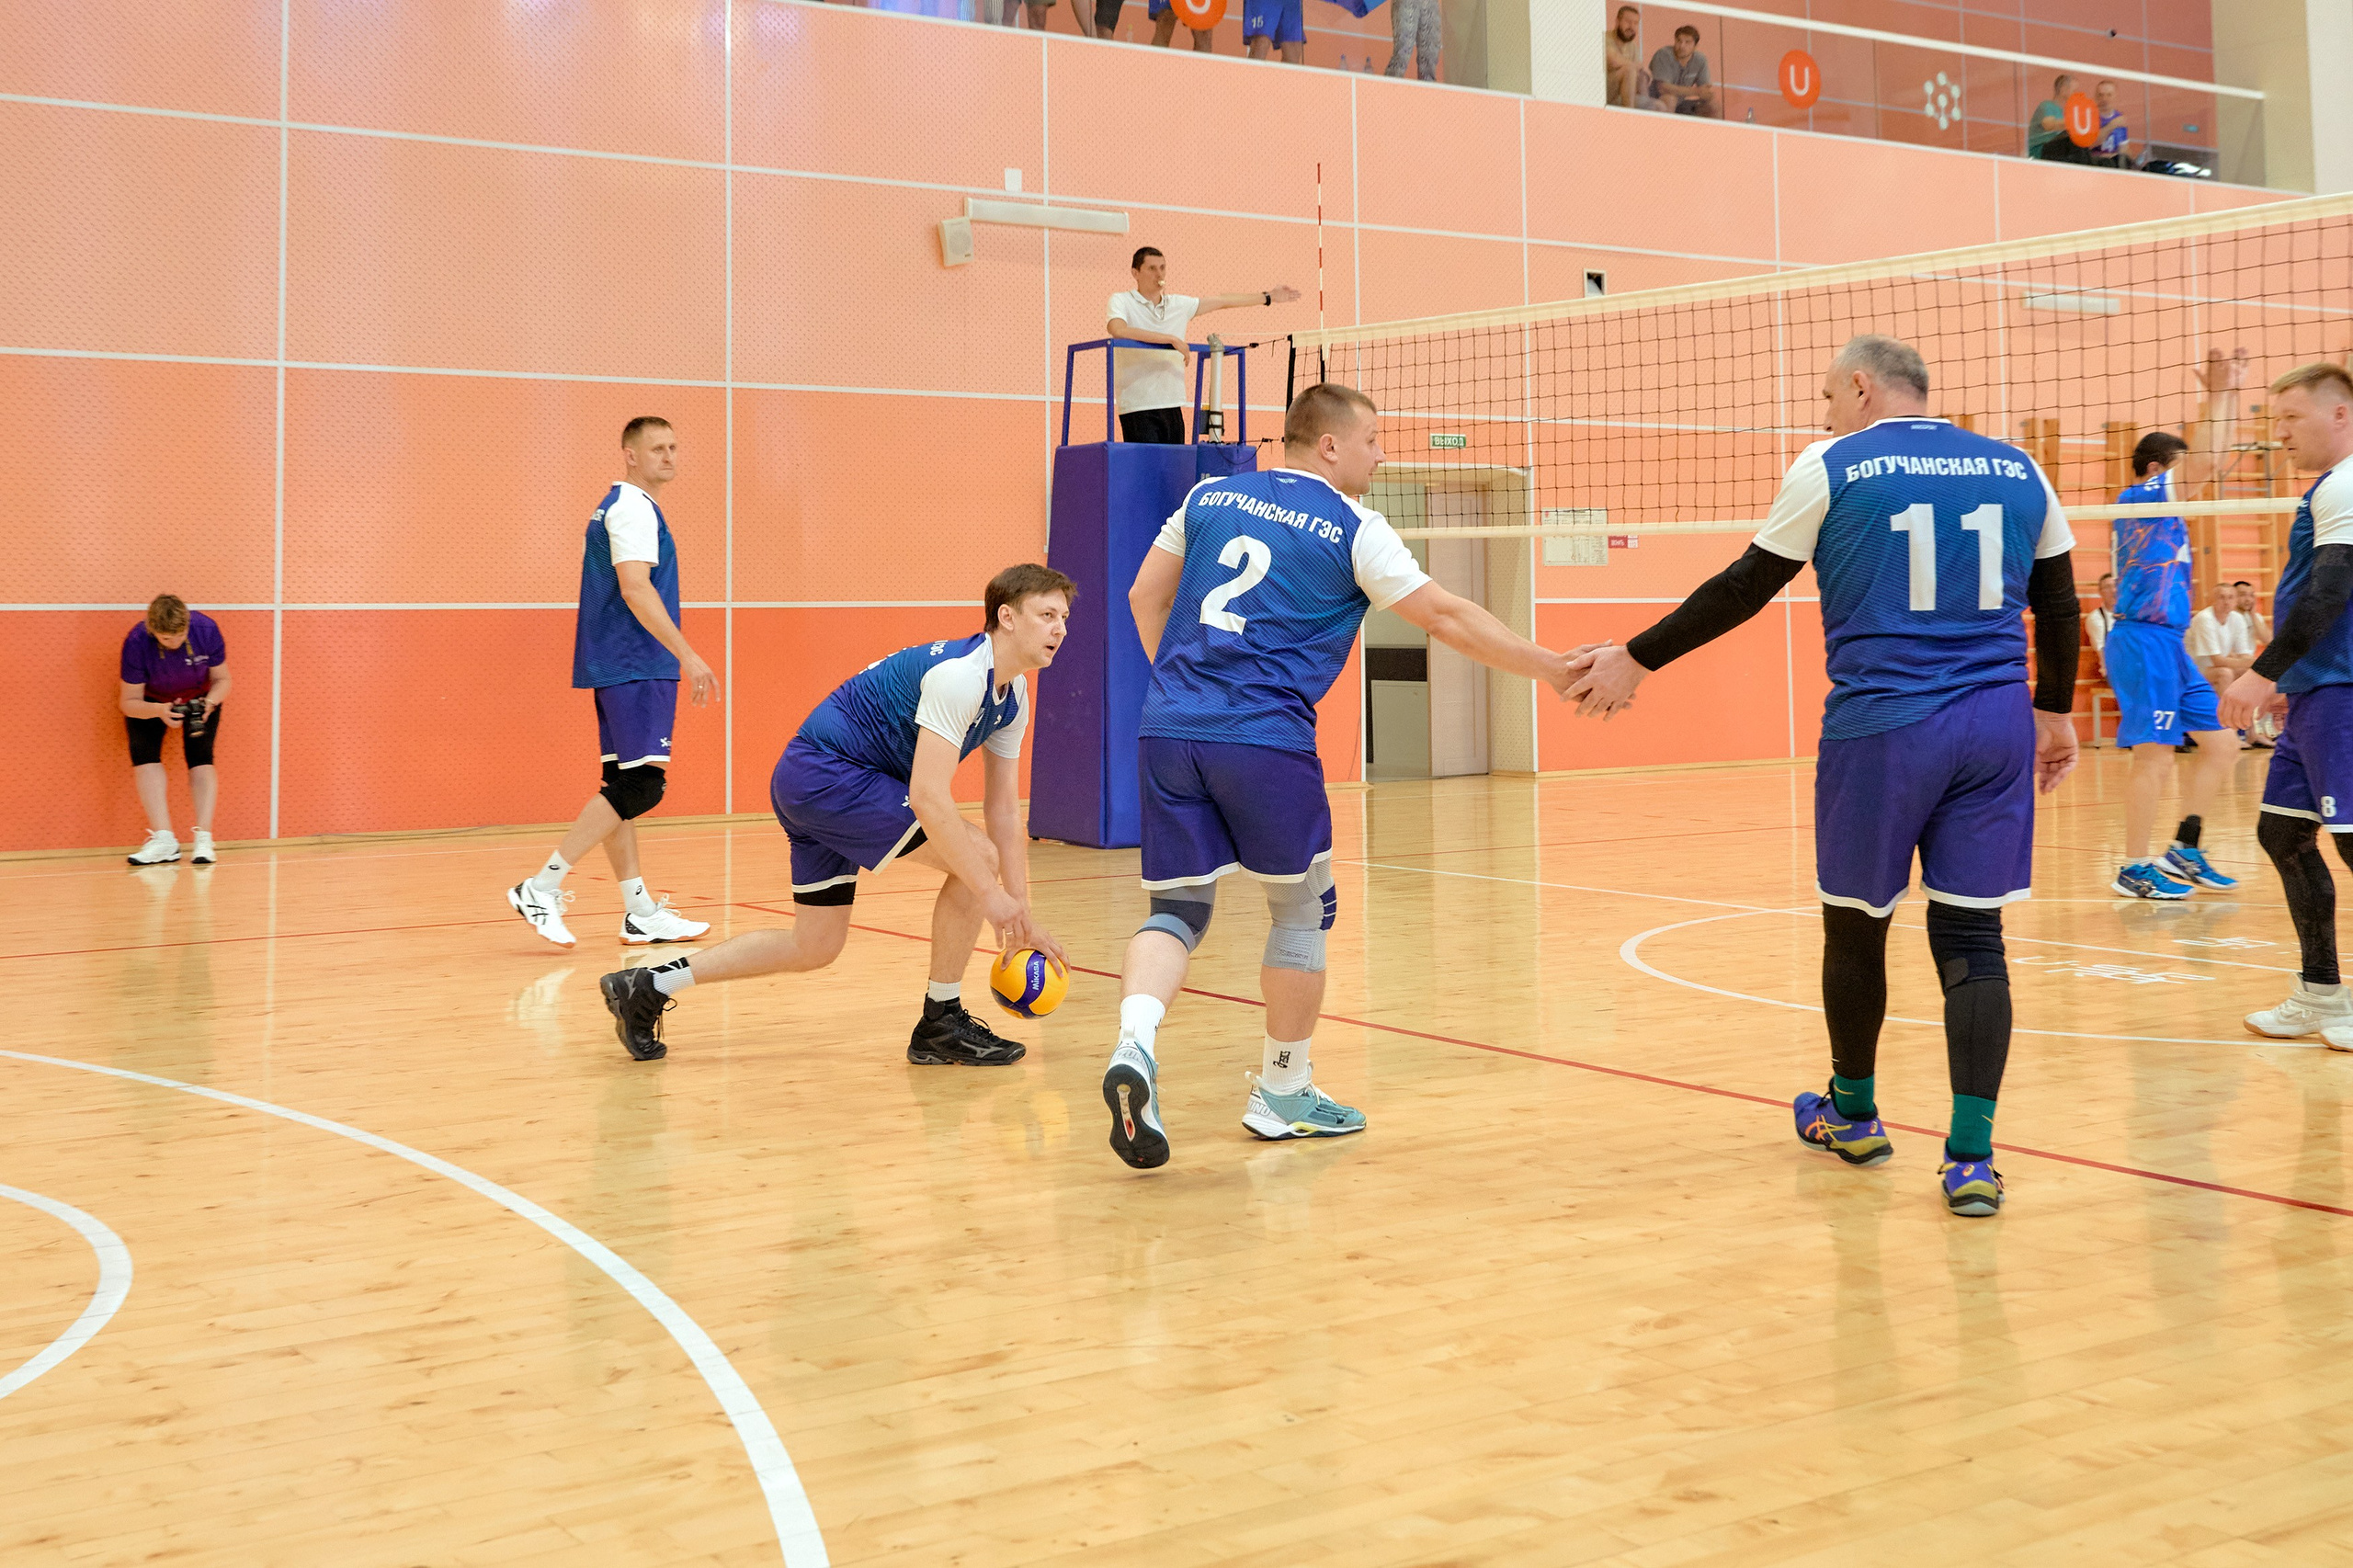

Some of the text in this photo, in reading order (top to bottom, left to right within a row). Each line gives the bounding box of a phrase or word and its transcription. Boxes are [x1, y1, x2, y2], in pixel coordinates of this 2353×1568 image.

[1434, 437, 1464, 447] ВЫХОД
[1845, 455, 2028, 483] БОГУЧАНСКАЯ ГЭС
[1198, 491, 1343, 544] БОГУЧАНСКАЯ ГЭС
[1890, 503, 2005, 611] 11
[1199, 535, 1272, 636] 2
[2153, 710, 2176, 730] 27
[2320, 795, 2336, 818] 8
